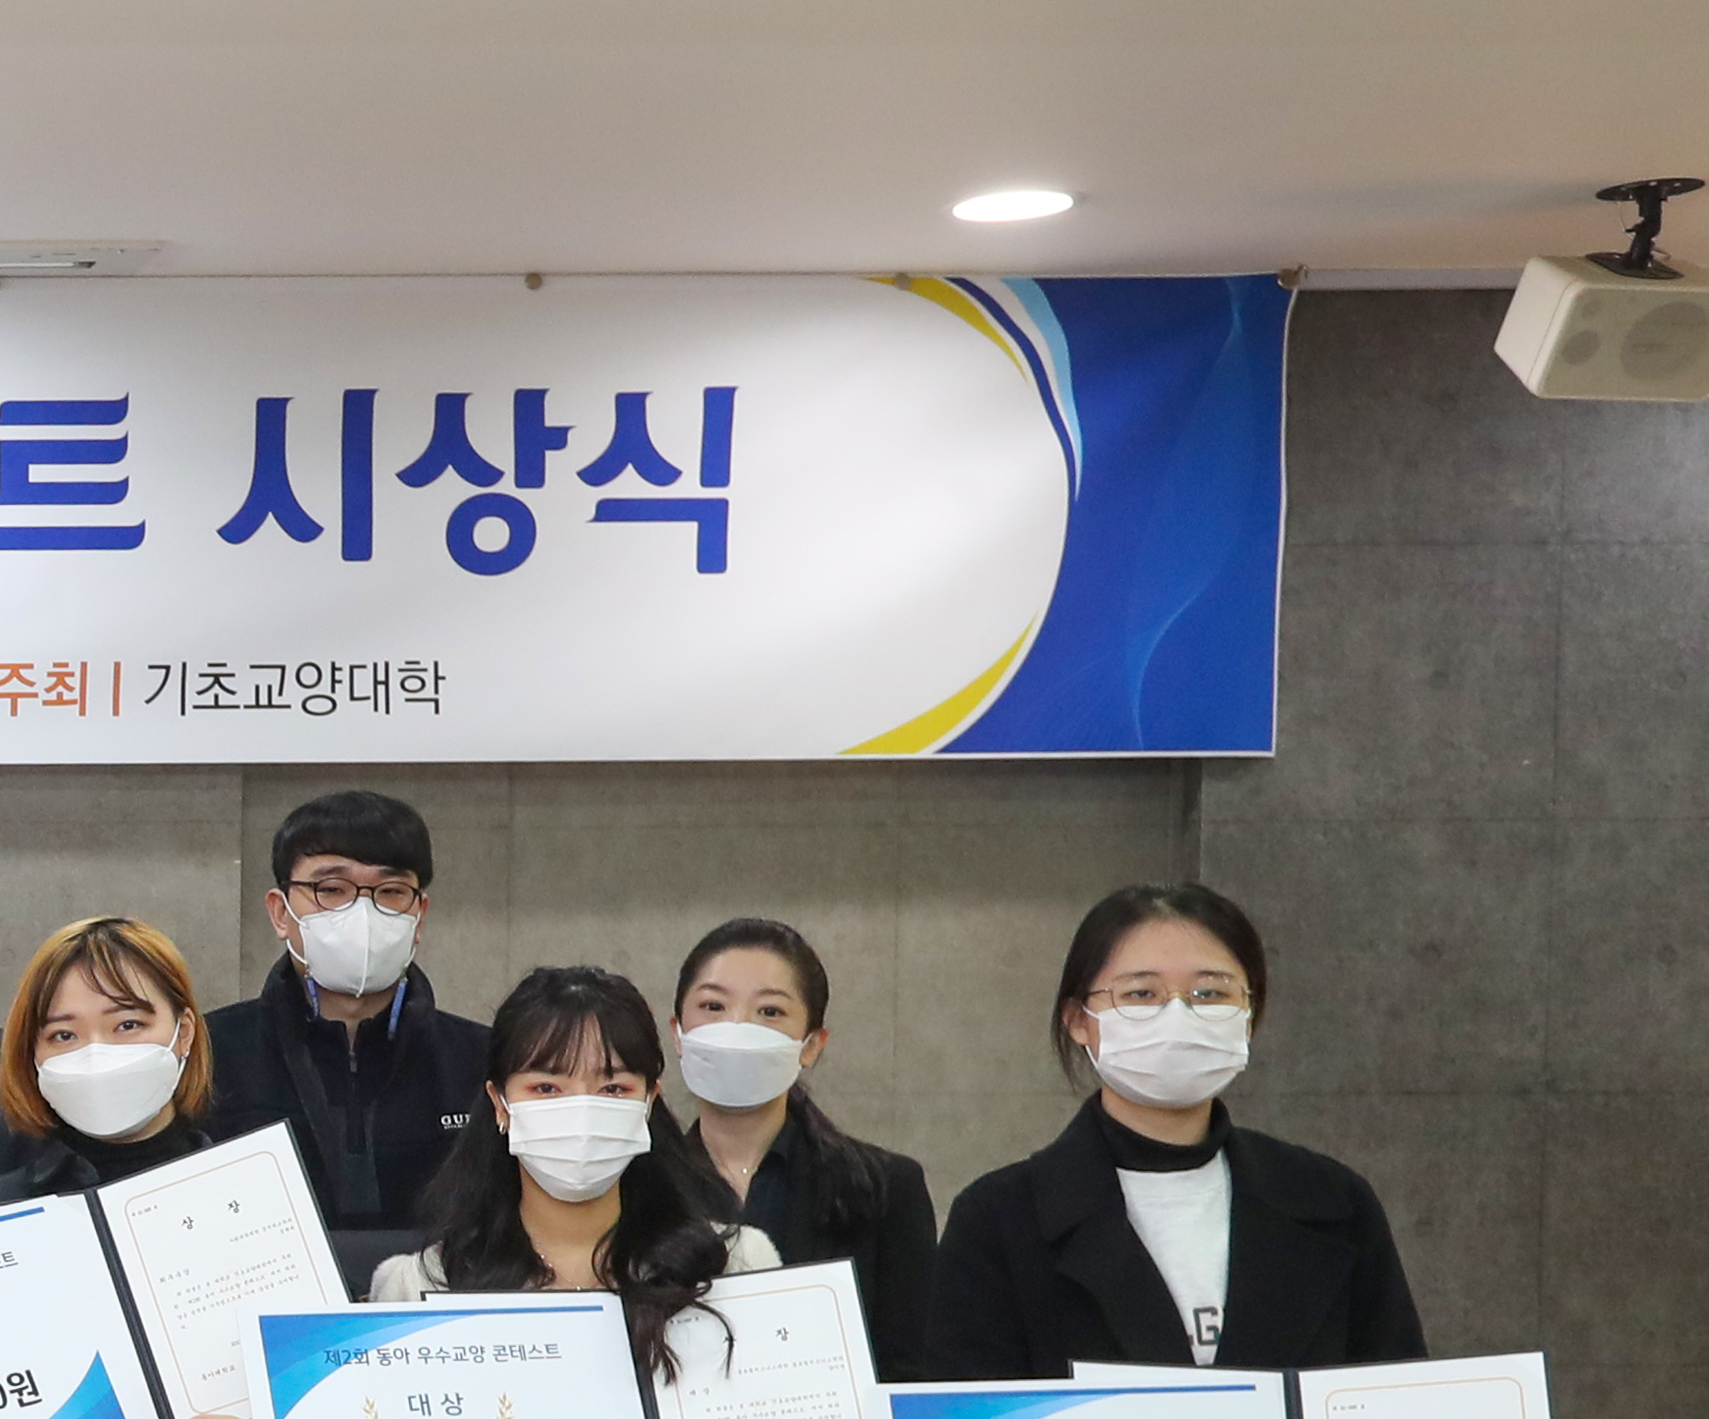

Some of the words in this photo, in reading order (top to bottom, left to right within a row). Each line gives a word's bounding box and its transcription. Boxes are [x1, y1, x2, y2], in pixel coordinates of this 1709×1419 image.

[215, 386, 738, 577] 시상식
[143, 659, 447, 717] 기초교양대학
[323, 1348, 371, 1369] 제2회
[375, 1347, 411, 1367] 동아
[416, 1345, 486, 1365] 우수교양
[492, 1343, 562, 1363] 콘테스트
